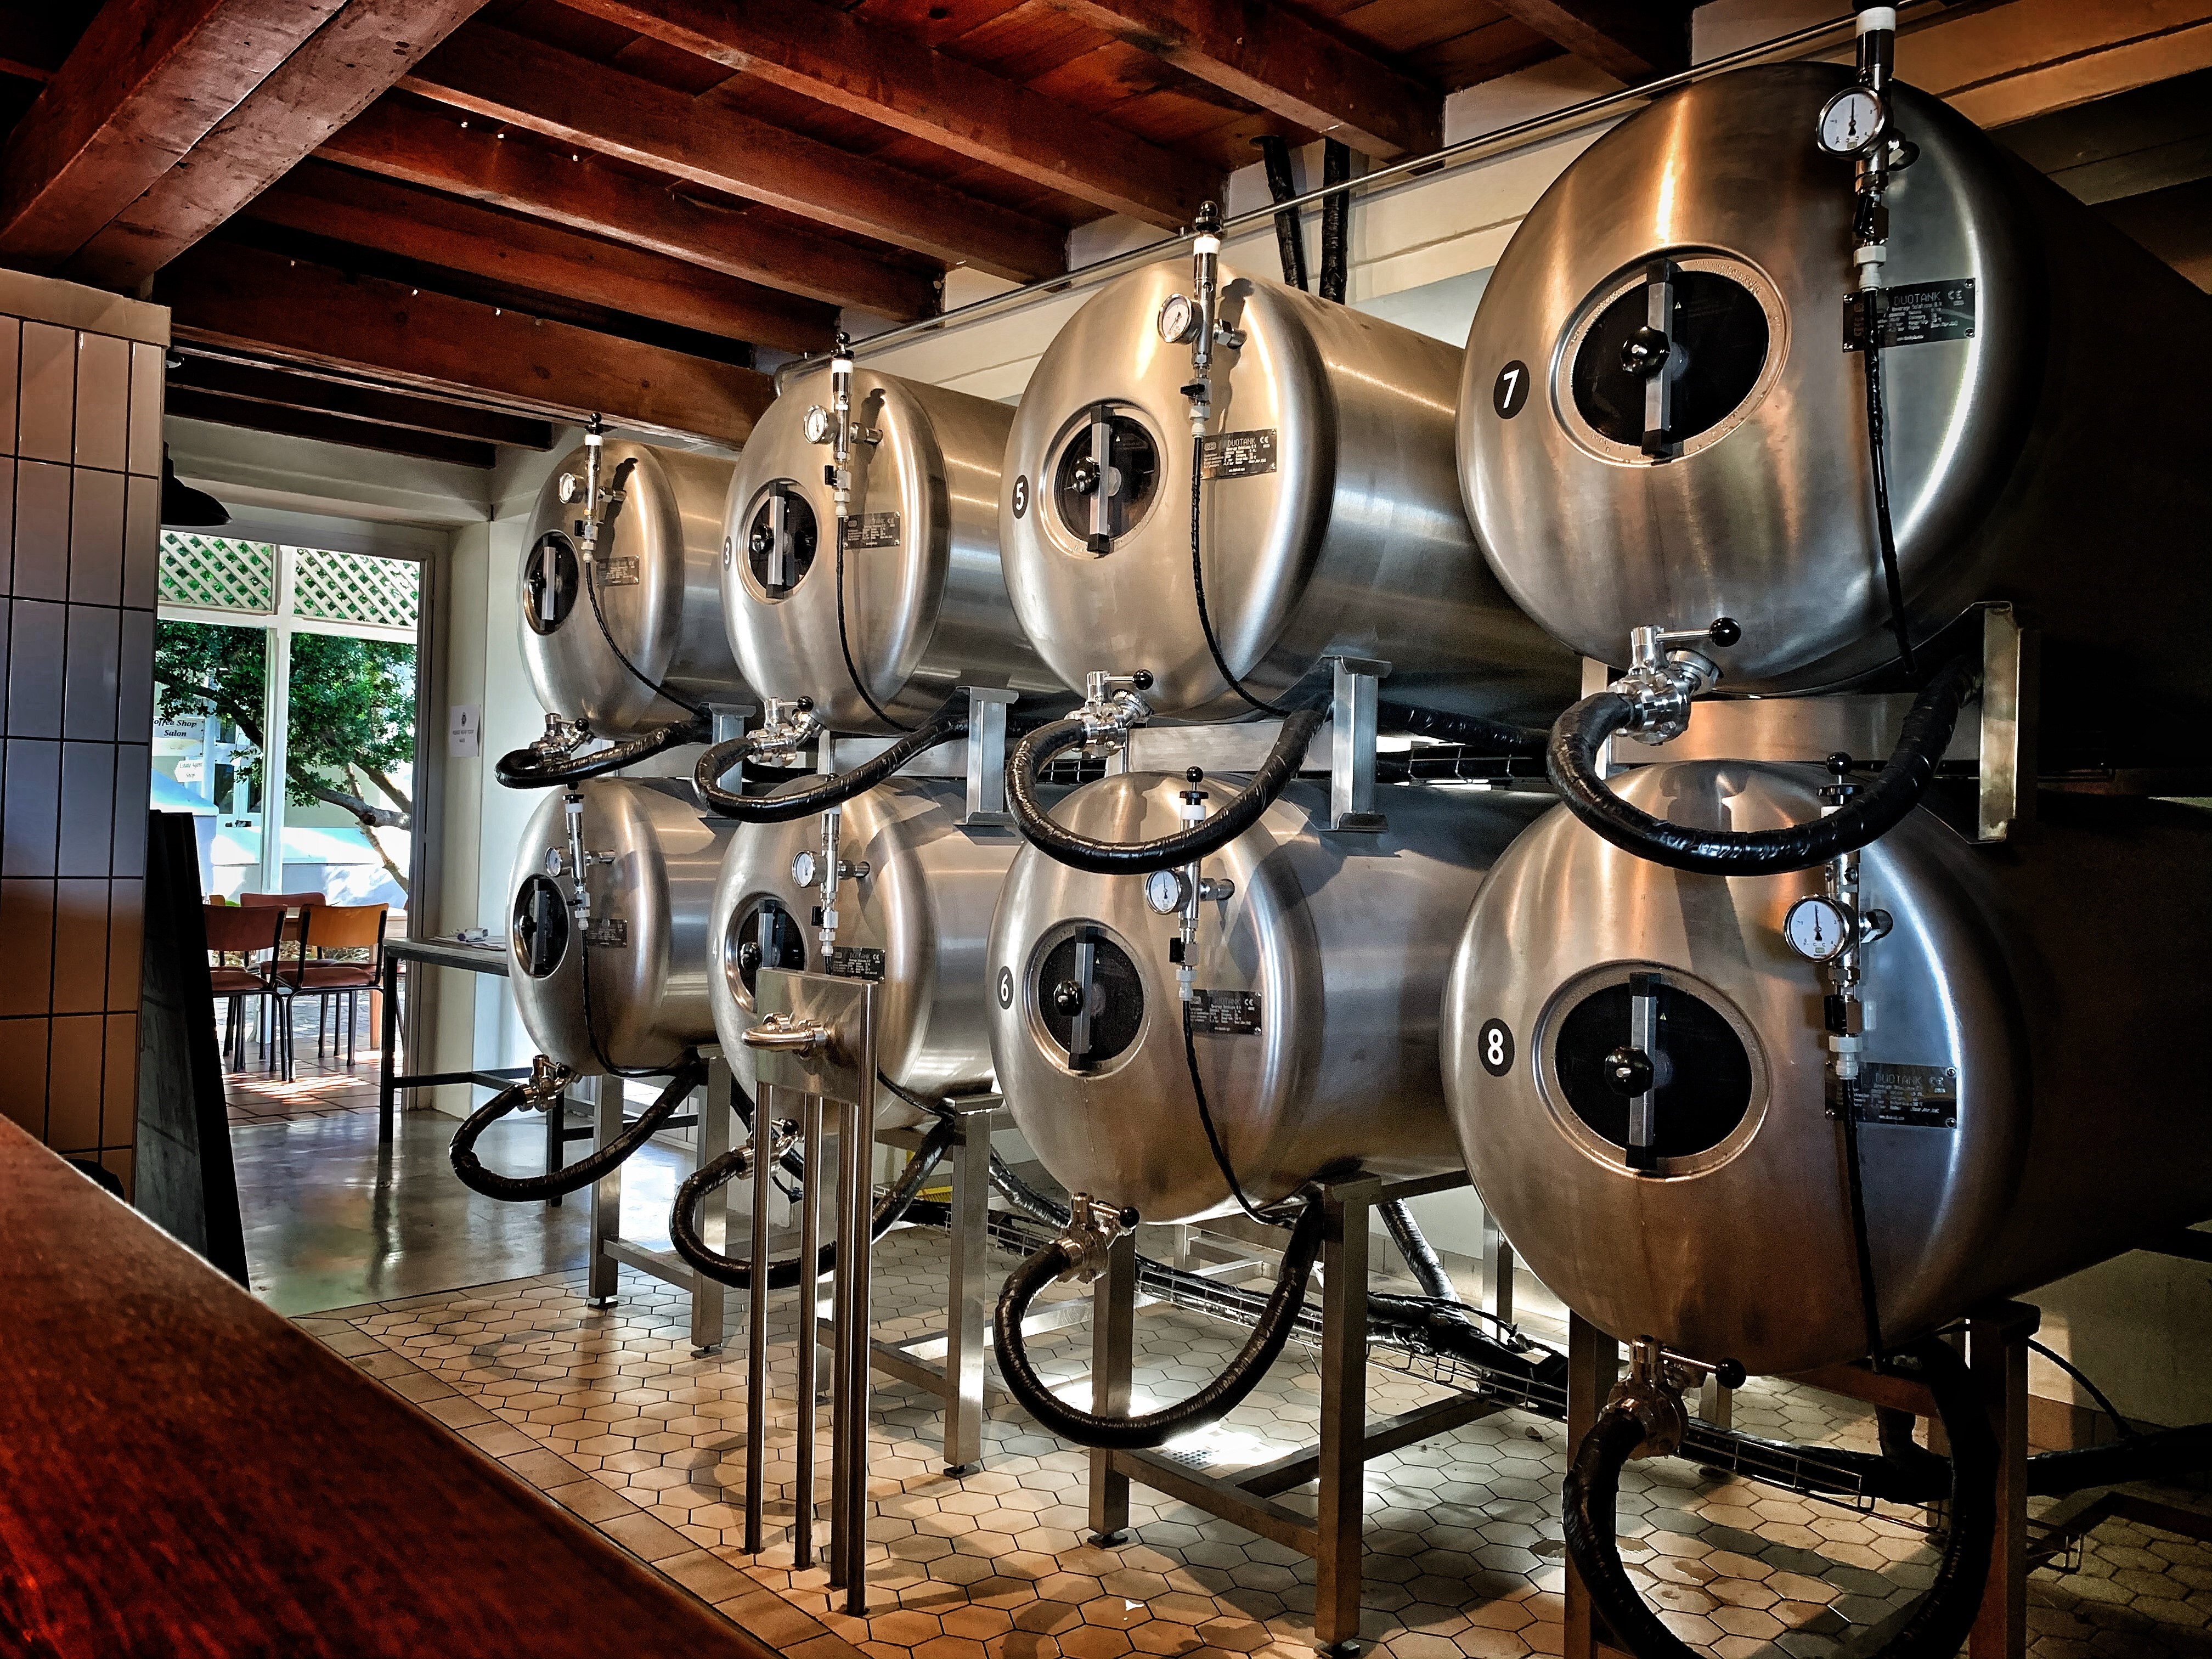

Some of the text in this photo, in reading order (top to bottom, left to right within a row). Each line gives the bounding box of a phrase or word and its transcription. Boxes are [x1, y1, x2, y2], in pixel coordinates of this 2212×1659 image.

[1894, 291, 1940, 306] DUOTANK
[1504, 369, 1519, 408] 7
[1227, 437, 1256, 447] DUOTANK
[1016, 482, 1024, 510] 5
[725, 542, 730, 564] 3
[177, 720, 197, 728] Shop
[713, 938, 718, 958] 4
[1001, 974, 1008, 1001] 6
[1488, 1029, 1503, 1065] 8
[1875, 1073, 1922, 1086] DUOTANK
